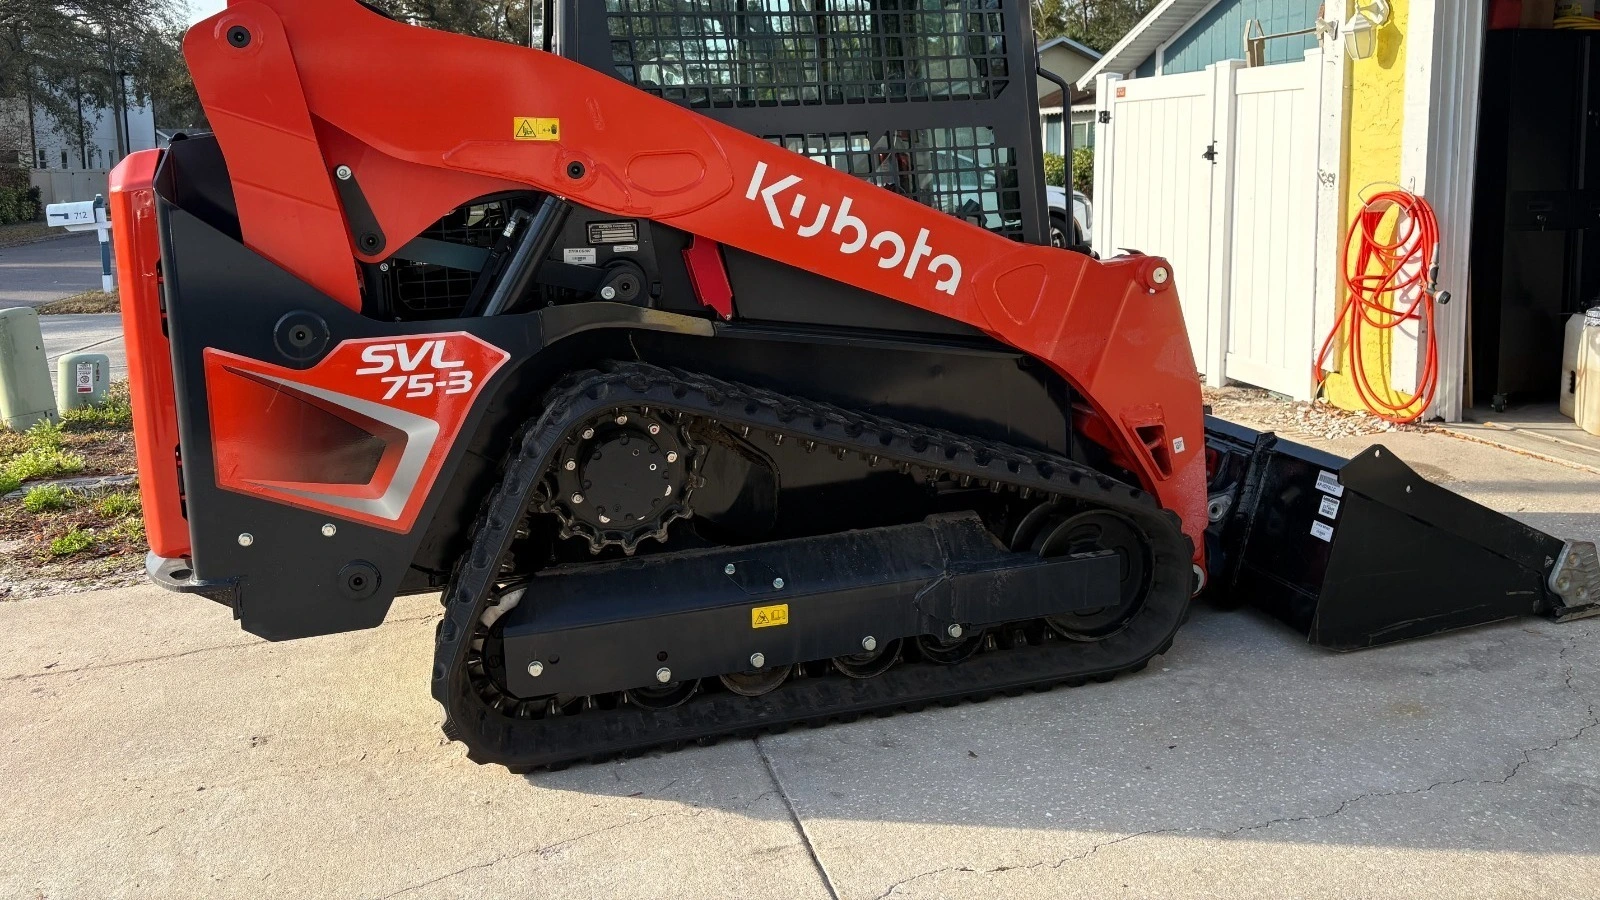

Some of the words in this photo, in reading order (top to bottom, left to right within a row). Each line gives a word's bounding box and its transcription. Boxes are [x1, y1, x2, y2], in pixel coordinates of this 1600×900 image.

[74, 212, 88, 220] 712
[745, 160, 962, 296] Kubota
[356, 340, 464, 375] SVL
[381, 370, 473, 400] 75-3
